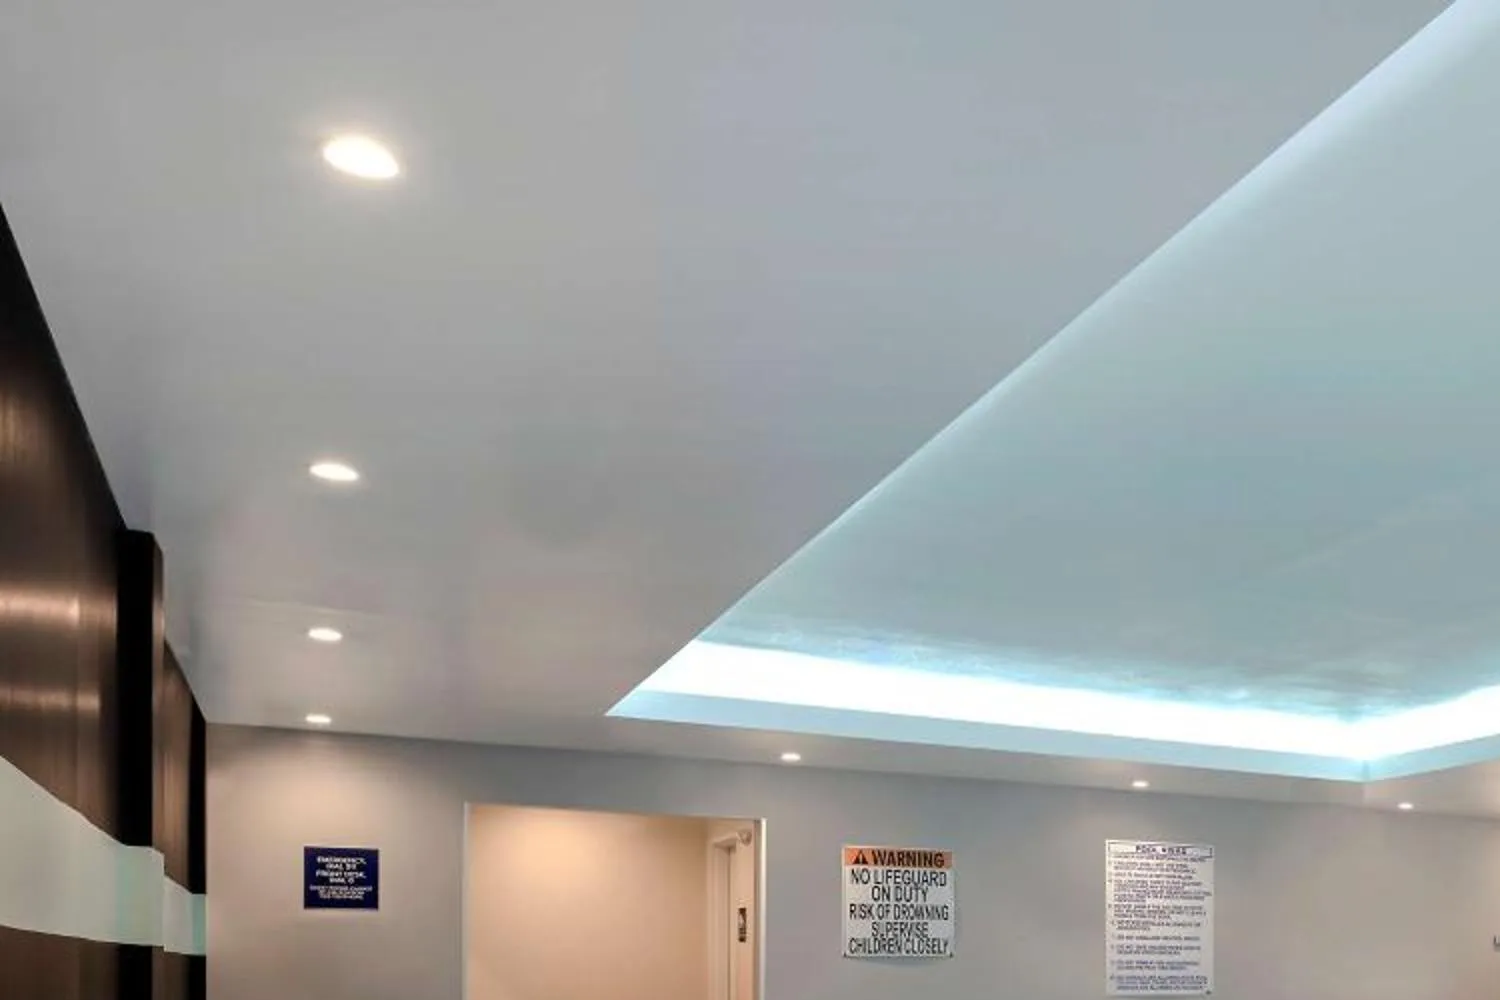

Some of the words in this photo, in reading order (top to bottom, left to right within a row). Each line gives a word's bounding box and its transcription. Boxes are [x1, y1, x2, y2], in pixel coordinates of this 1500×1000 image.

[872, 850, 945, 868] WARNING
[850, 868, 871, 884] NO
[874, 869, 948, 887] LIFEGUARD
[871, 885, 891, 902] ON
[894, 886, 929, 903] DUTY
[849, 903, 874, 920] RISK
[877, 903, 891, 920] OF
[893, 903, 949, 921] DROWNING
[871, 921, 929, 938] SUPERVISE
[848, 937, 903, 954] CHILDREN
